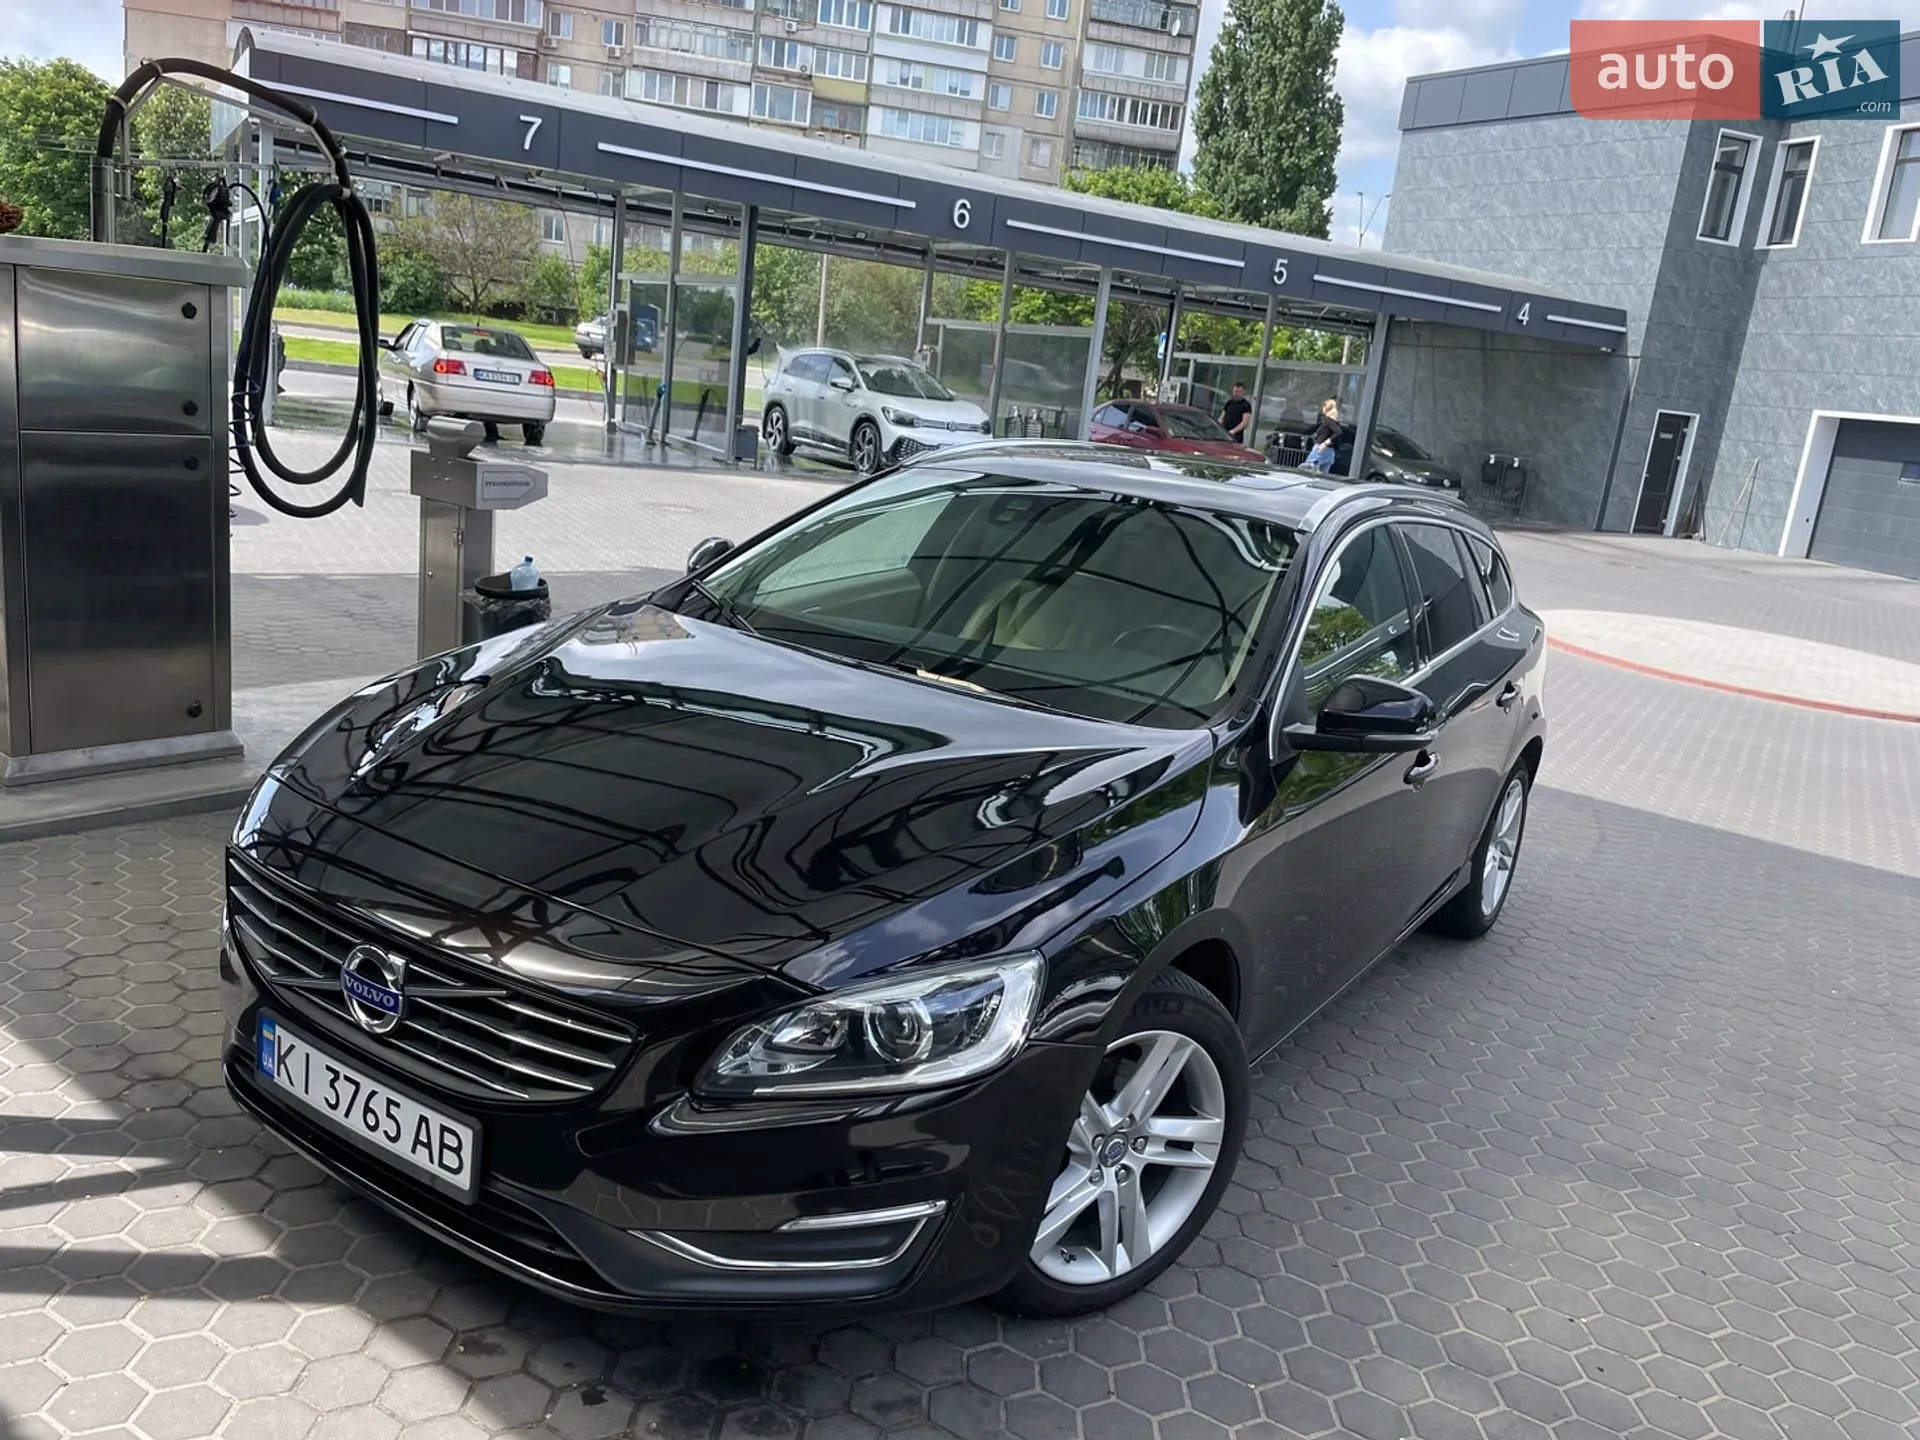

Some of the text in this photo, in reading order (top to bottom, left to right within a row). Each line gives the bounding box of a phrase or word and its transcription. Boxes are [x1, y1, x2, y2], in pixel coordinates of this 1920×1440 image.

[520, 115, 543, 150] 7
[953, 198, 971, 229] 6
[1273, 258, 1288, 285] 5
[1518, 302, 1531, 325] 4
[344, 976, 395, 1007] VOLVO
[262, 1052, 275, 1071] UA
[276, 1036, 464, 1175] KI 3765 AB
